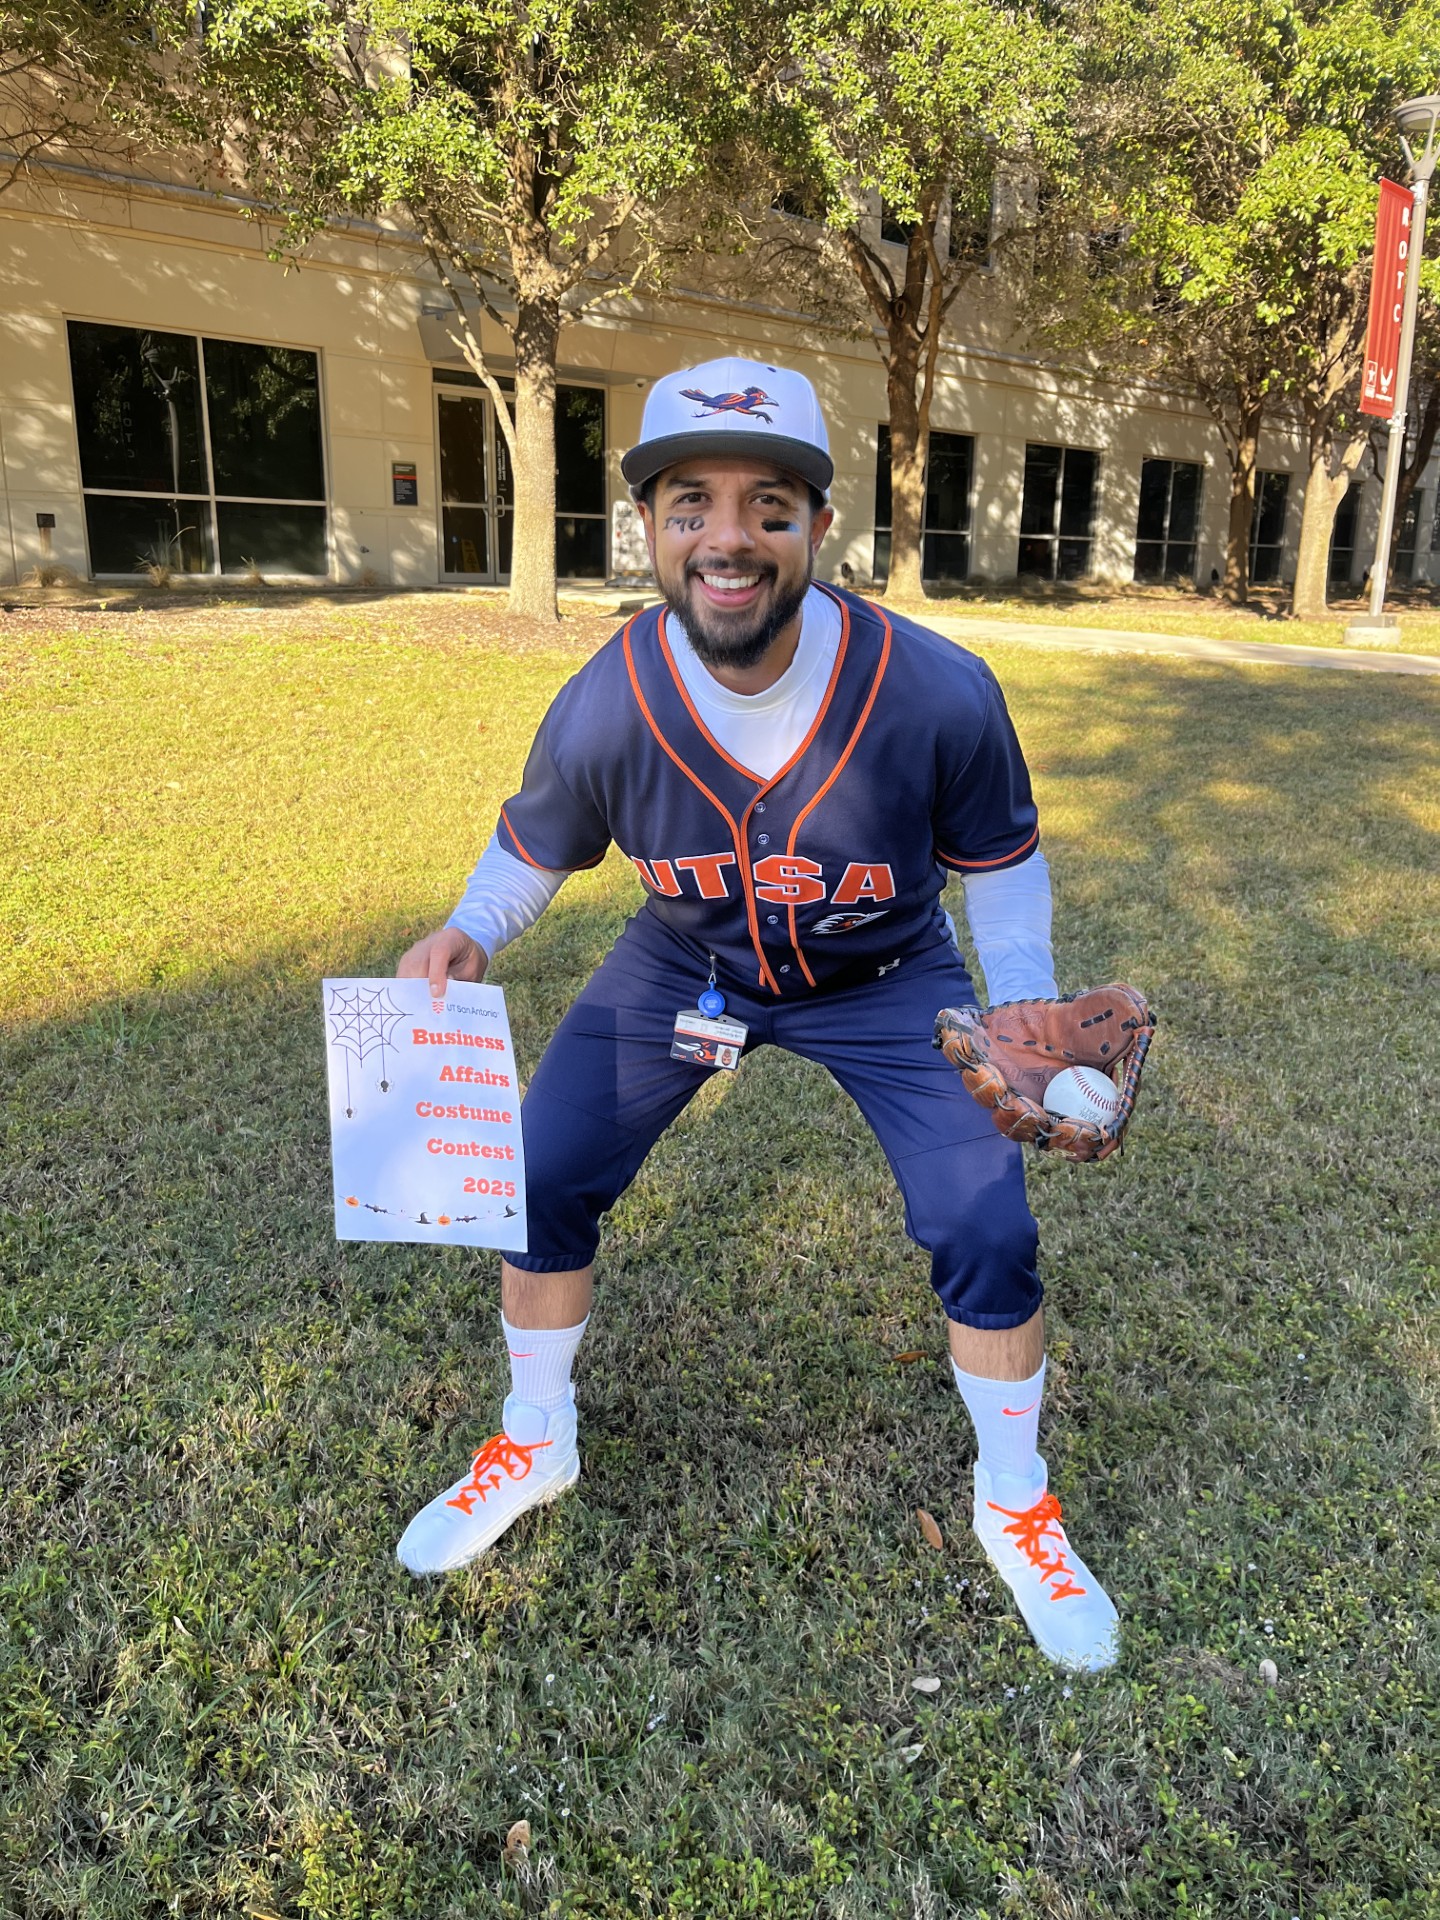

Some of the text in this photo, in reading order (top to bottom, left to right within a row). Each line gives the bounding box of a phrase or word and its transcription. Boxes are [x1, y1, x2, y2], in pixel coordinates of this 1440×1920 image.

[1393, 206, 1410, 323] ROTC
[630, 851, 896, 905] UTSA
[446, 1003, 498, 1018] UT San Antonio
[412, 1028, 505, 1051] Business
[439, 1065, 510, 1088] Affairs
[415, 1101, 513, 1124] Costume
[426, 1138, 515, 1161] Contest
[463, 1177, 516, 1198] 2025
